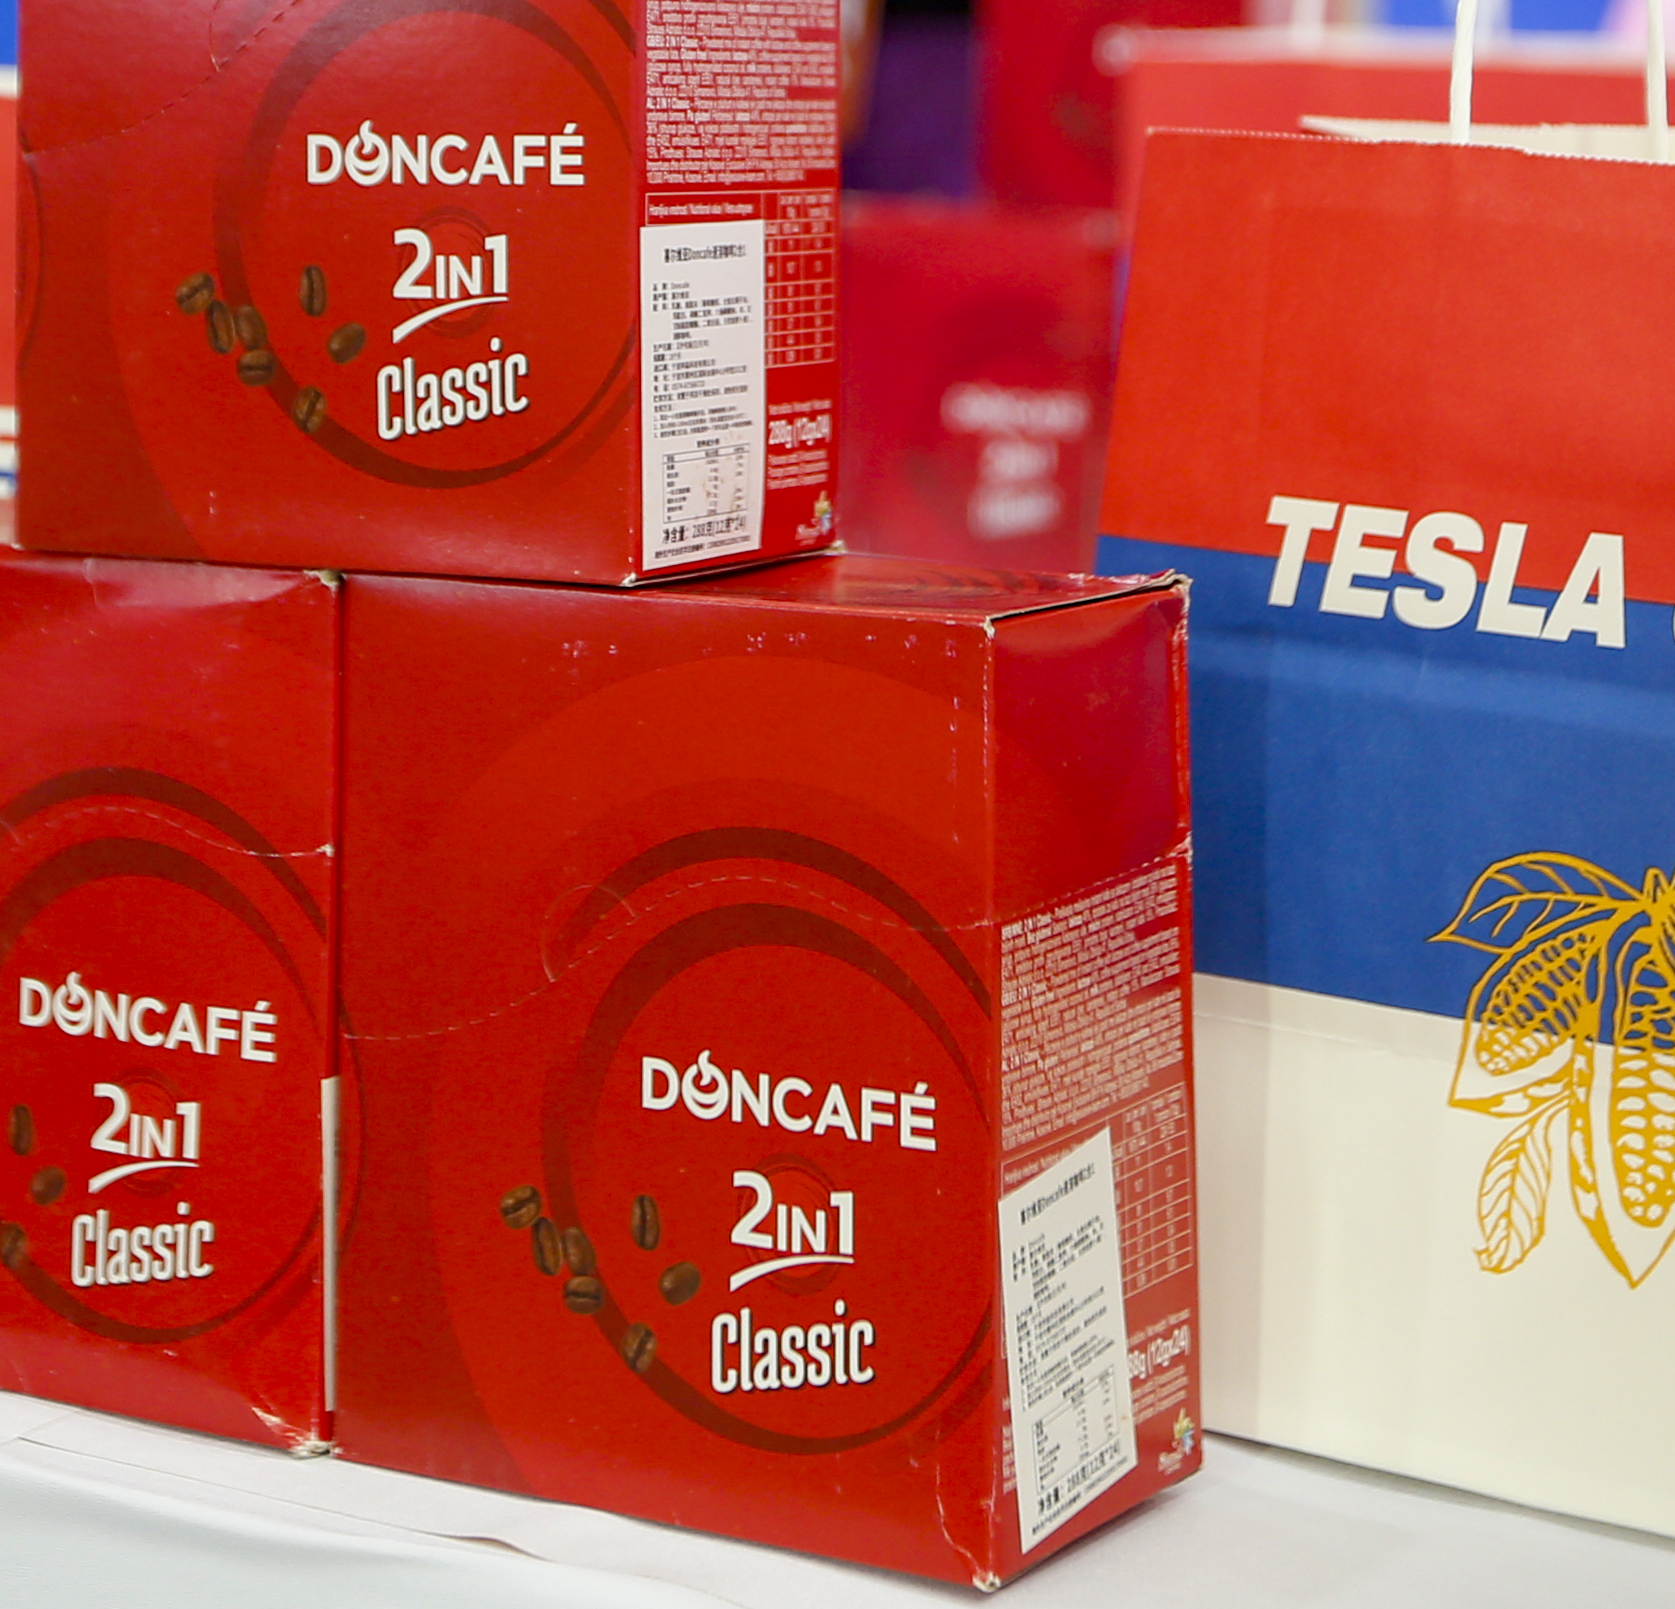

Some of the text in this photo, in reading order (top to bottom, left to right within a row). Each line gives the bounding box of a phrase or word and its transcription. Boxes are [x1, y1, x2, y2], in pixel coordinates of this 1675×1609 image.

[307, 118, 585, 185] DONCAFÉ
[378, 336, 529, 439] Classic
[1267, 496, 1625, 648] TESLA
[20, 972, 277, 1062] DONCAFÉ
[642, 1050, 937, 1151] DONCAFÉ
[72, 1201, 214, 1286] Classic
[712, 1298, 874, 1392] Classic
